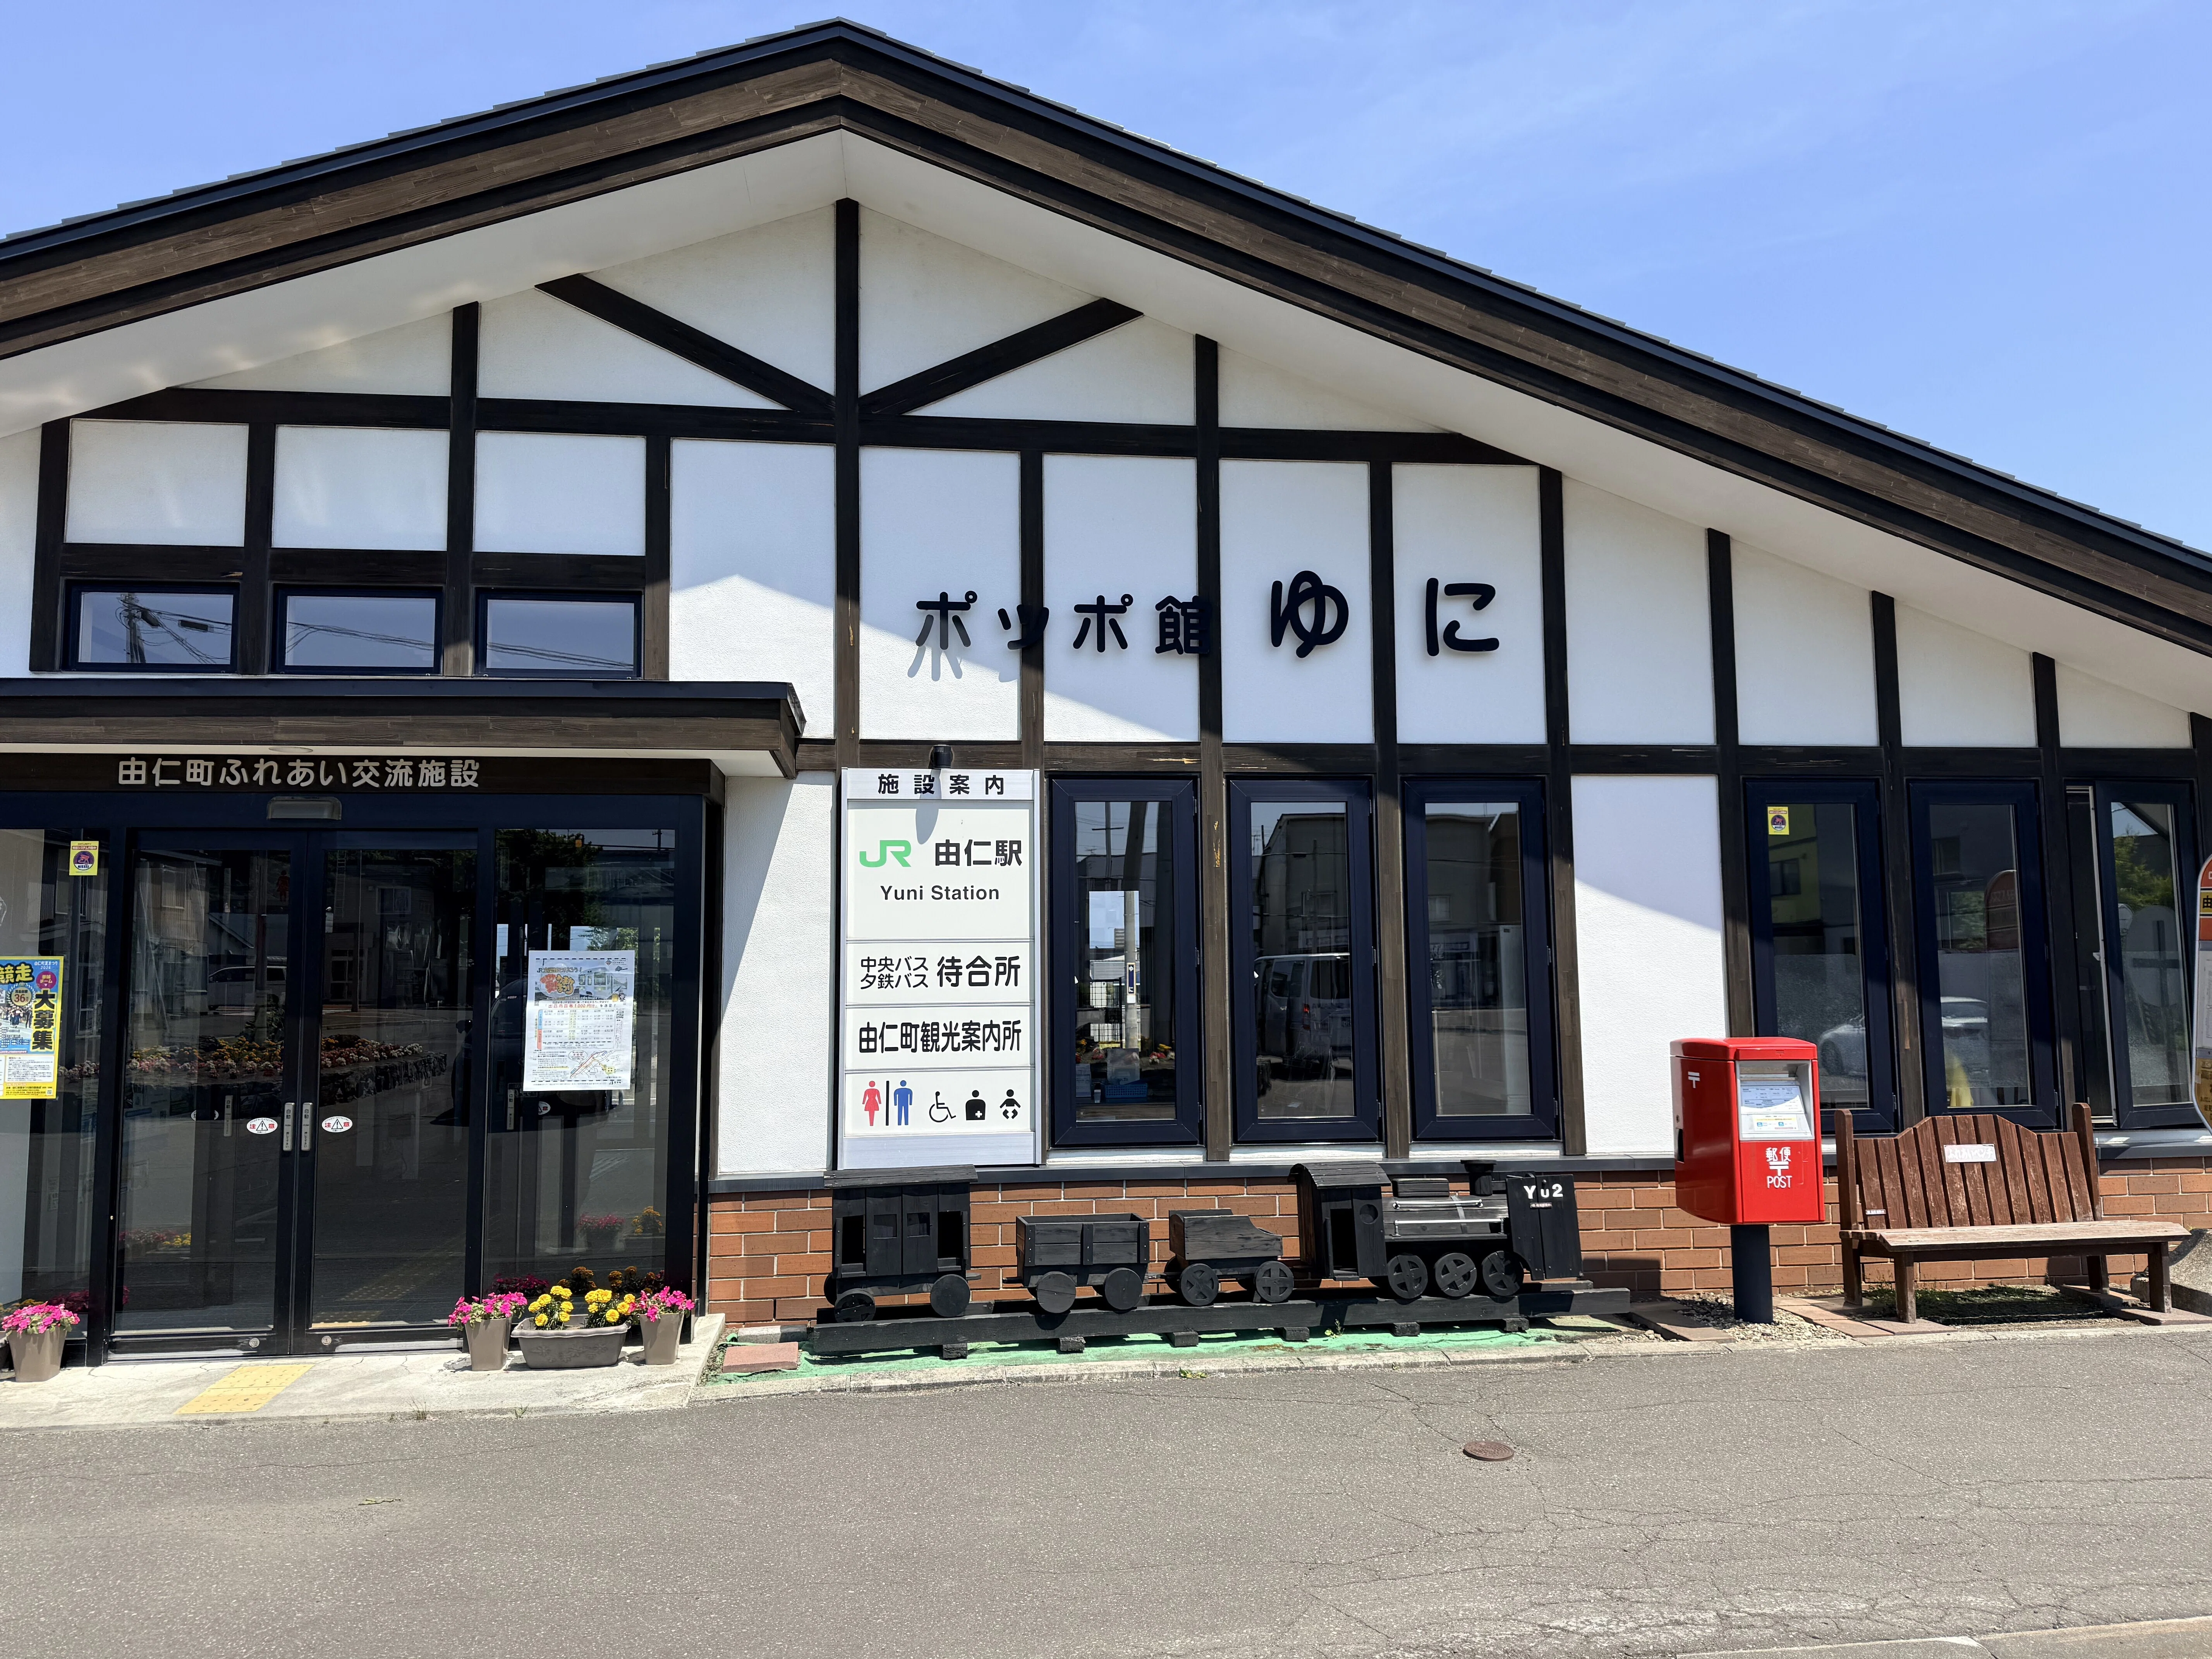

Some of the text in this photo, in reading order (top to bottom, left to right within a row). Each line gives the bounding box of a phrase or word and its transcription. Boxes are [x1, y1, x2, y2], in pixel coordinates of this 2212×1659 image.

[916, 570, 1499, 658] ポッポ館 ゆに
[118, 757, 479, 787] 由仁町ふれあい交流施設
[878, 774, 1004, 795] 施設案内
[859, 839, 1022, 868] JR 由仁駅
[880, 885, 999, 900] Yuni Station
[861, 956, 928, 972] 中央バス
[937, 955, 1020, 987] 待合所
[860, 973, 928, 989] 夕鉄バス
[32, 990, 56, 1050] 大募集
[859, 1020, 1022, 1053] 由仁町観光案内所
[1765, 1147, 1791, 1162] 郵便
[1523, 1183, 1563, 1199] Yu2
[1767, 1176, 1792, 1188] POST
